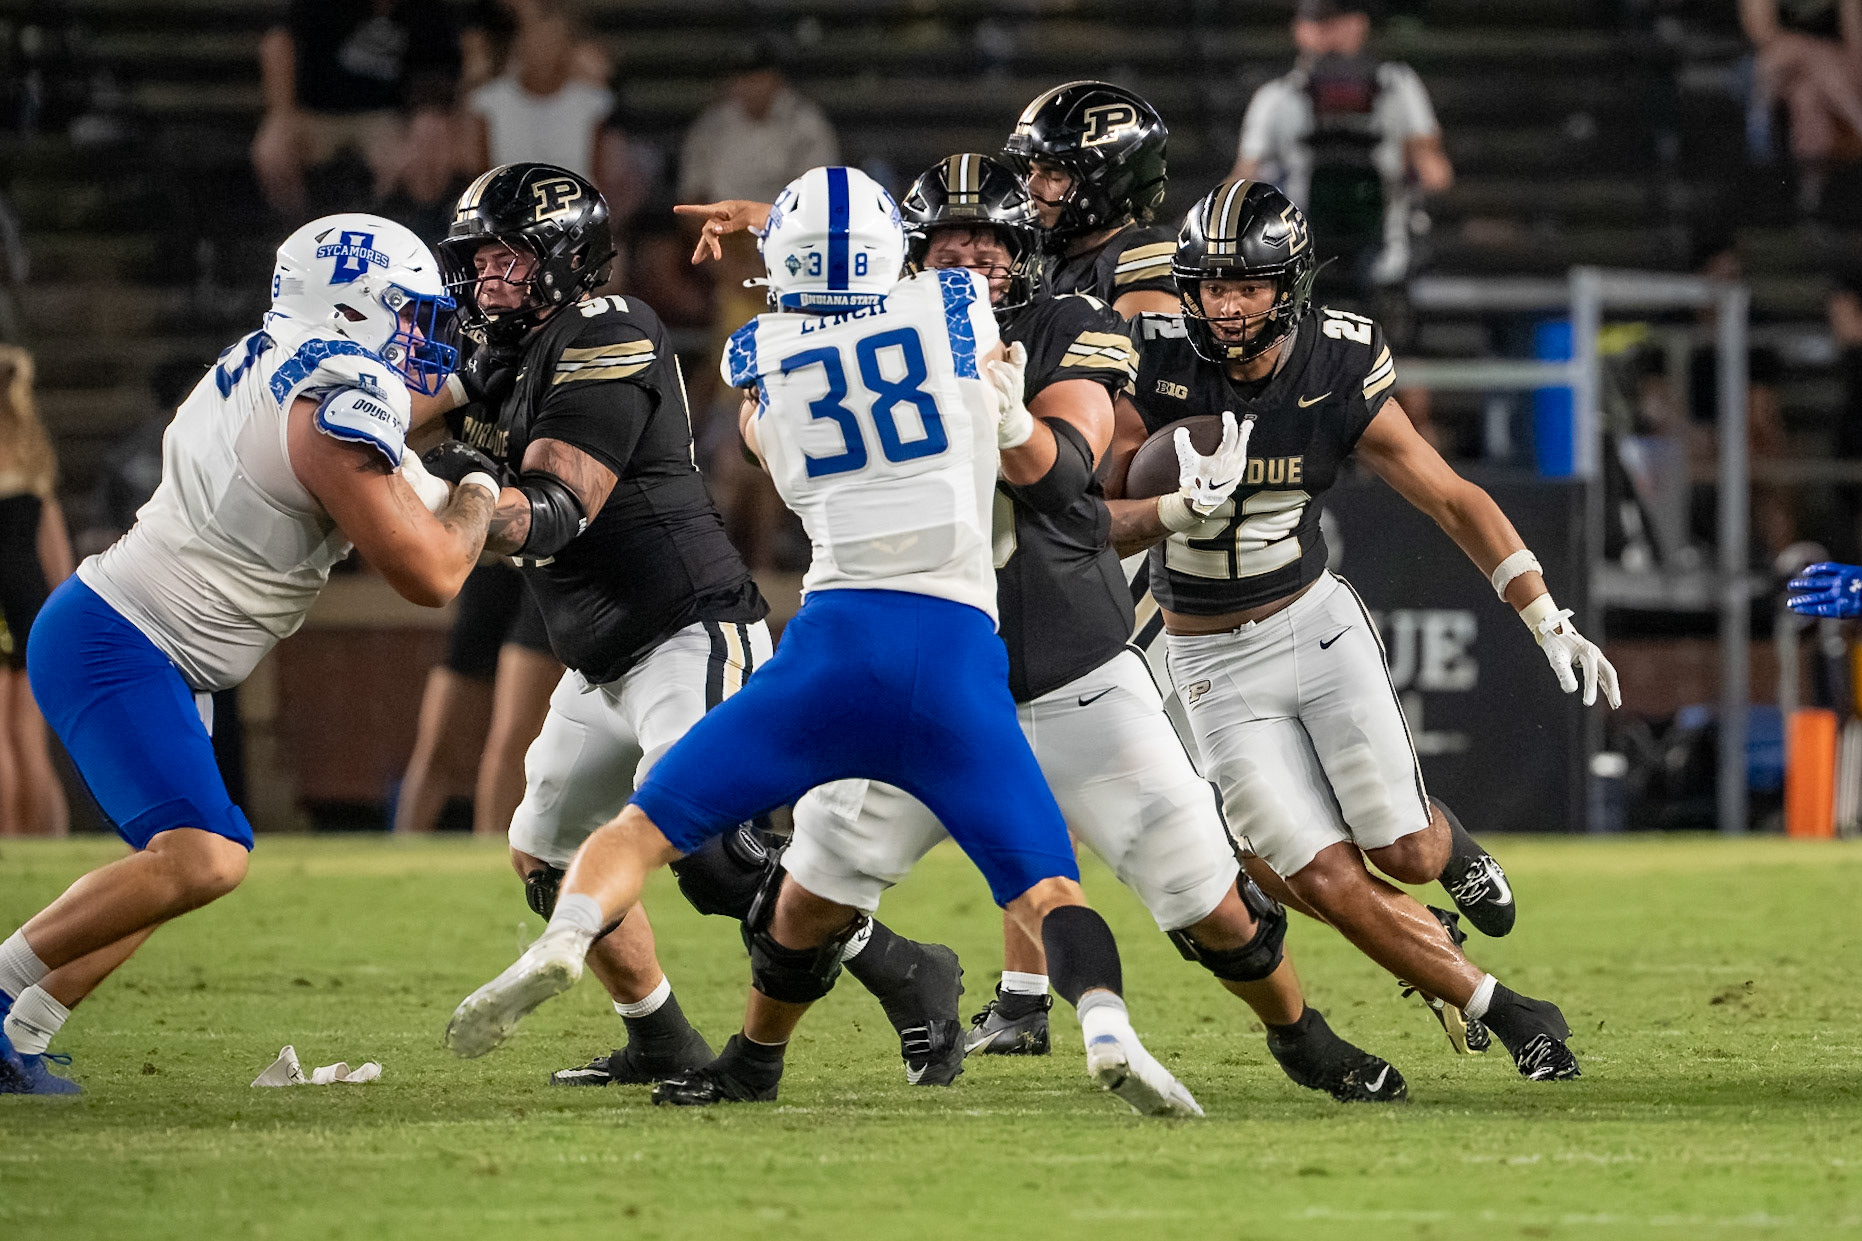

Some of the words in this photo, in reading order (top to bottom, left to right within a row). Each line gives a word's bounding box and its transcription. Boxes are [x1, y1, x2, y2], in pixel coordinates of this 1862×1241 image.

[1081, 103, 1137, 148] P
[532, 177, 582, 222] P
[316, 244, 390, 269] SYCAMORES
[808, 252, 822, 277] 3
[855, 252, 868, 277] 8
[800, 293, 848, 307] INDIANA
[850, 295, 880, 306] STATE
[780, 327, 949, 479] 38
[1164, 489, 1312, 580] 22
[1189, 679, 1211, 704] P
